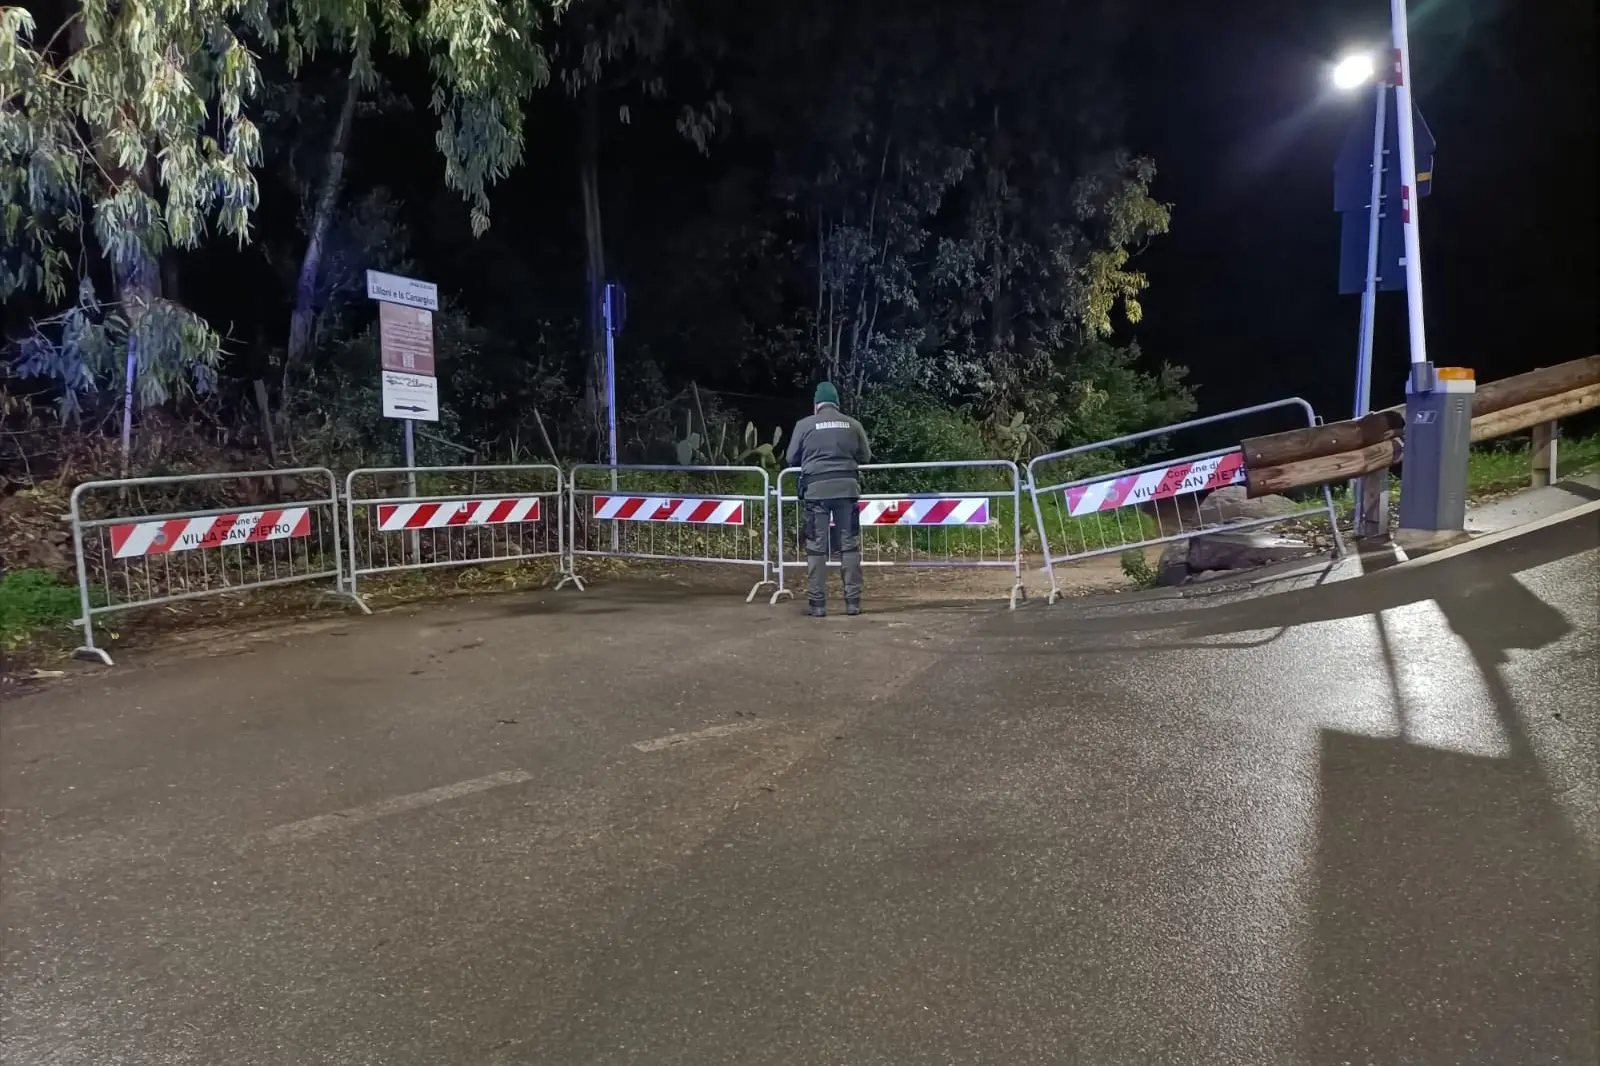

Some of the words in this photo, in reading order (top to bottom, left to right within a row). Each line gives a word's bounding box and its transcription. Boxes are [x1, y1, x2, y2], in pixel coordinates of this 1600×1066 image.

[1167, 464, 1207, 479] Comune
[1210, 461, 1219, 470] di
[1134, 483, 1170, 498] VILLA
[1174, 476, 1203, 490] SAN
[1208, 466, 1248, 484] PIETR
[215, 517, 250, 527] Comune
[252, 516, 260, 524] di
[182, 532, 217, 545] VILLA
[221, 529, 246, 541] SAN
[249, 523, 290, 538] PIETRO
